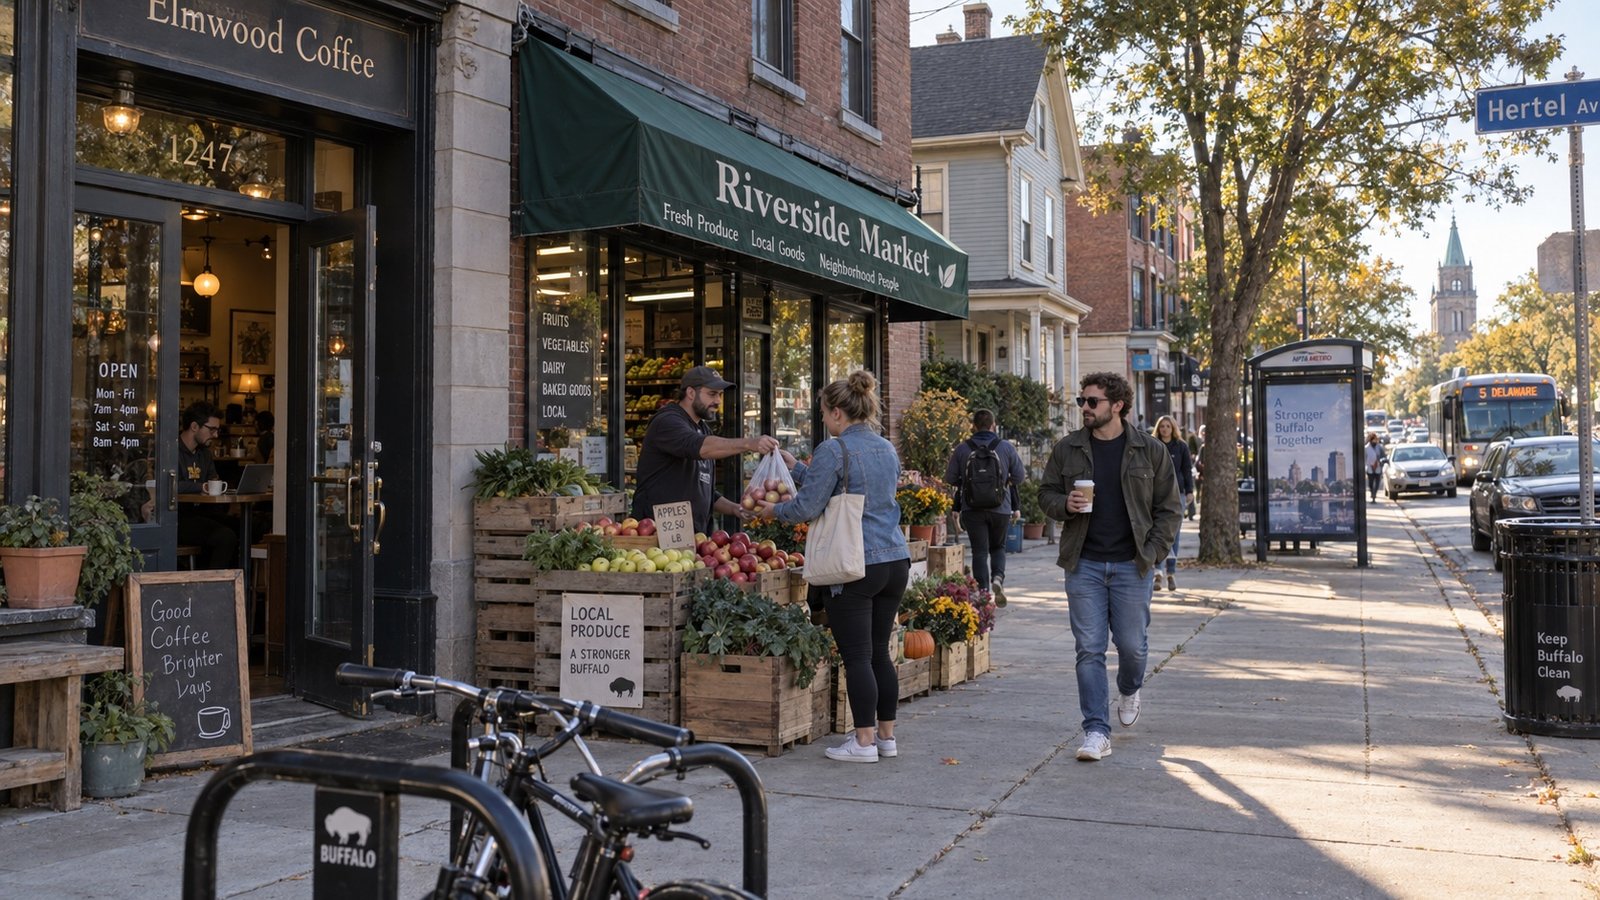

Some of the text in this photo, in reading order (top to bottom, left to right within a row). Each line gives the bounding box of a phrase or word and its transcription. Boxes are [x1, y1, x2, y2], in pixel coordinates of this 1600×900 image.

[147, 0, 375, 79] Elmwood Coffee
[1488, 93, 1566, 122] Hertel
[168, 134, 233, 172] 1247
[663, 202, 739, 242] Fresh Produce
[715, 160, 930, 277] Riverside Market
[751, 230, 806, 262] Local Goods
[819, 252, 900, 292] Neighborhood People
[542, 312, 570, 328] FRUITS
[542, 337, 590, 354] VEGETABLES
[99, 362, 138, 379] OPEN
[542, 360, 566, 375] DAIRY
[96, 387, 115, 399] Mon
[123, 388, 135, 400] Fri
[542, 383, 592, 397] BAKED GOODS
[1479, 386, 1538, 399] 5 DELAWARE
[93, 403, 112, 414] 7am
[119, 404, 139, 417] 4pm
[1274, 397, 1283, 408] A
[542, 405, 567, 419] LOCAL
[1274, 410, 1324, 424] Stronger
[95, 420, 110, 432] Sat
[118, 421, 135, 432] Sun
[1275, 422, 1315, 433] Buffalo
[93, 436, 112, 448] 8am
[120, 436, 140, 450] 4pm
[1275, 434, 1324, 448] Together
[657, 504, 688, 518] APPLES
[671, 533, 682, 543] LB
[150, 597, 192, 622] Good
[571, 606, 614, 621] LOCAL
[150, 624, 211, 650] Coffee
[570, 624, 631, 639] PRODUCE
[1537, 631, 1568, 648] Keep
[569, 648, 631, 660] A STRONGER
[1537, 649, 1584, 664] Buffalo
[162, 650, 223, 678] Brighter
[570, 663, 610, 674] BUFFALO
[1537, 666, 1571, 679] Clean
[320, 844, 377, 869] BUFFALO
